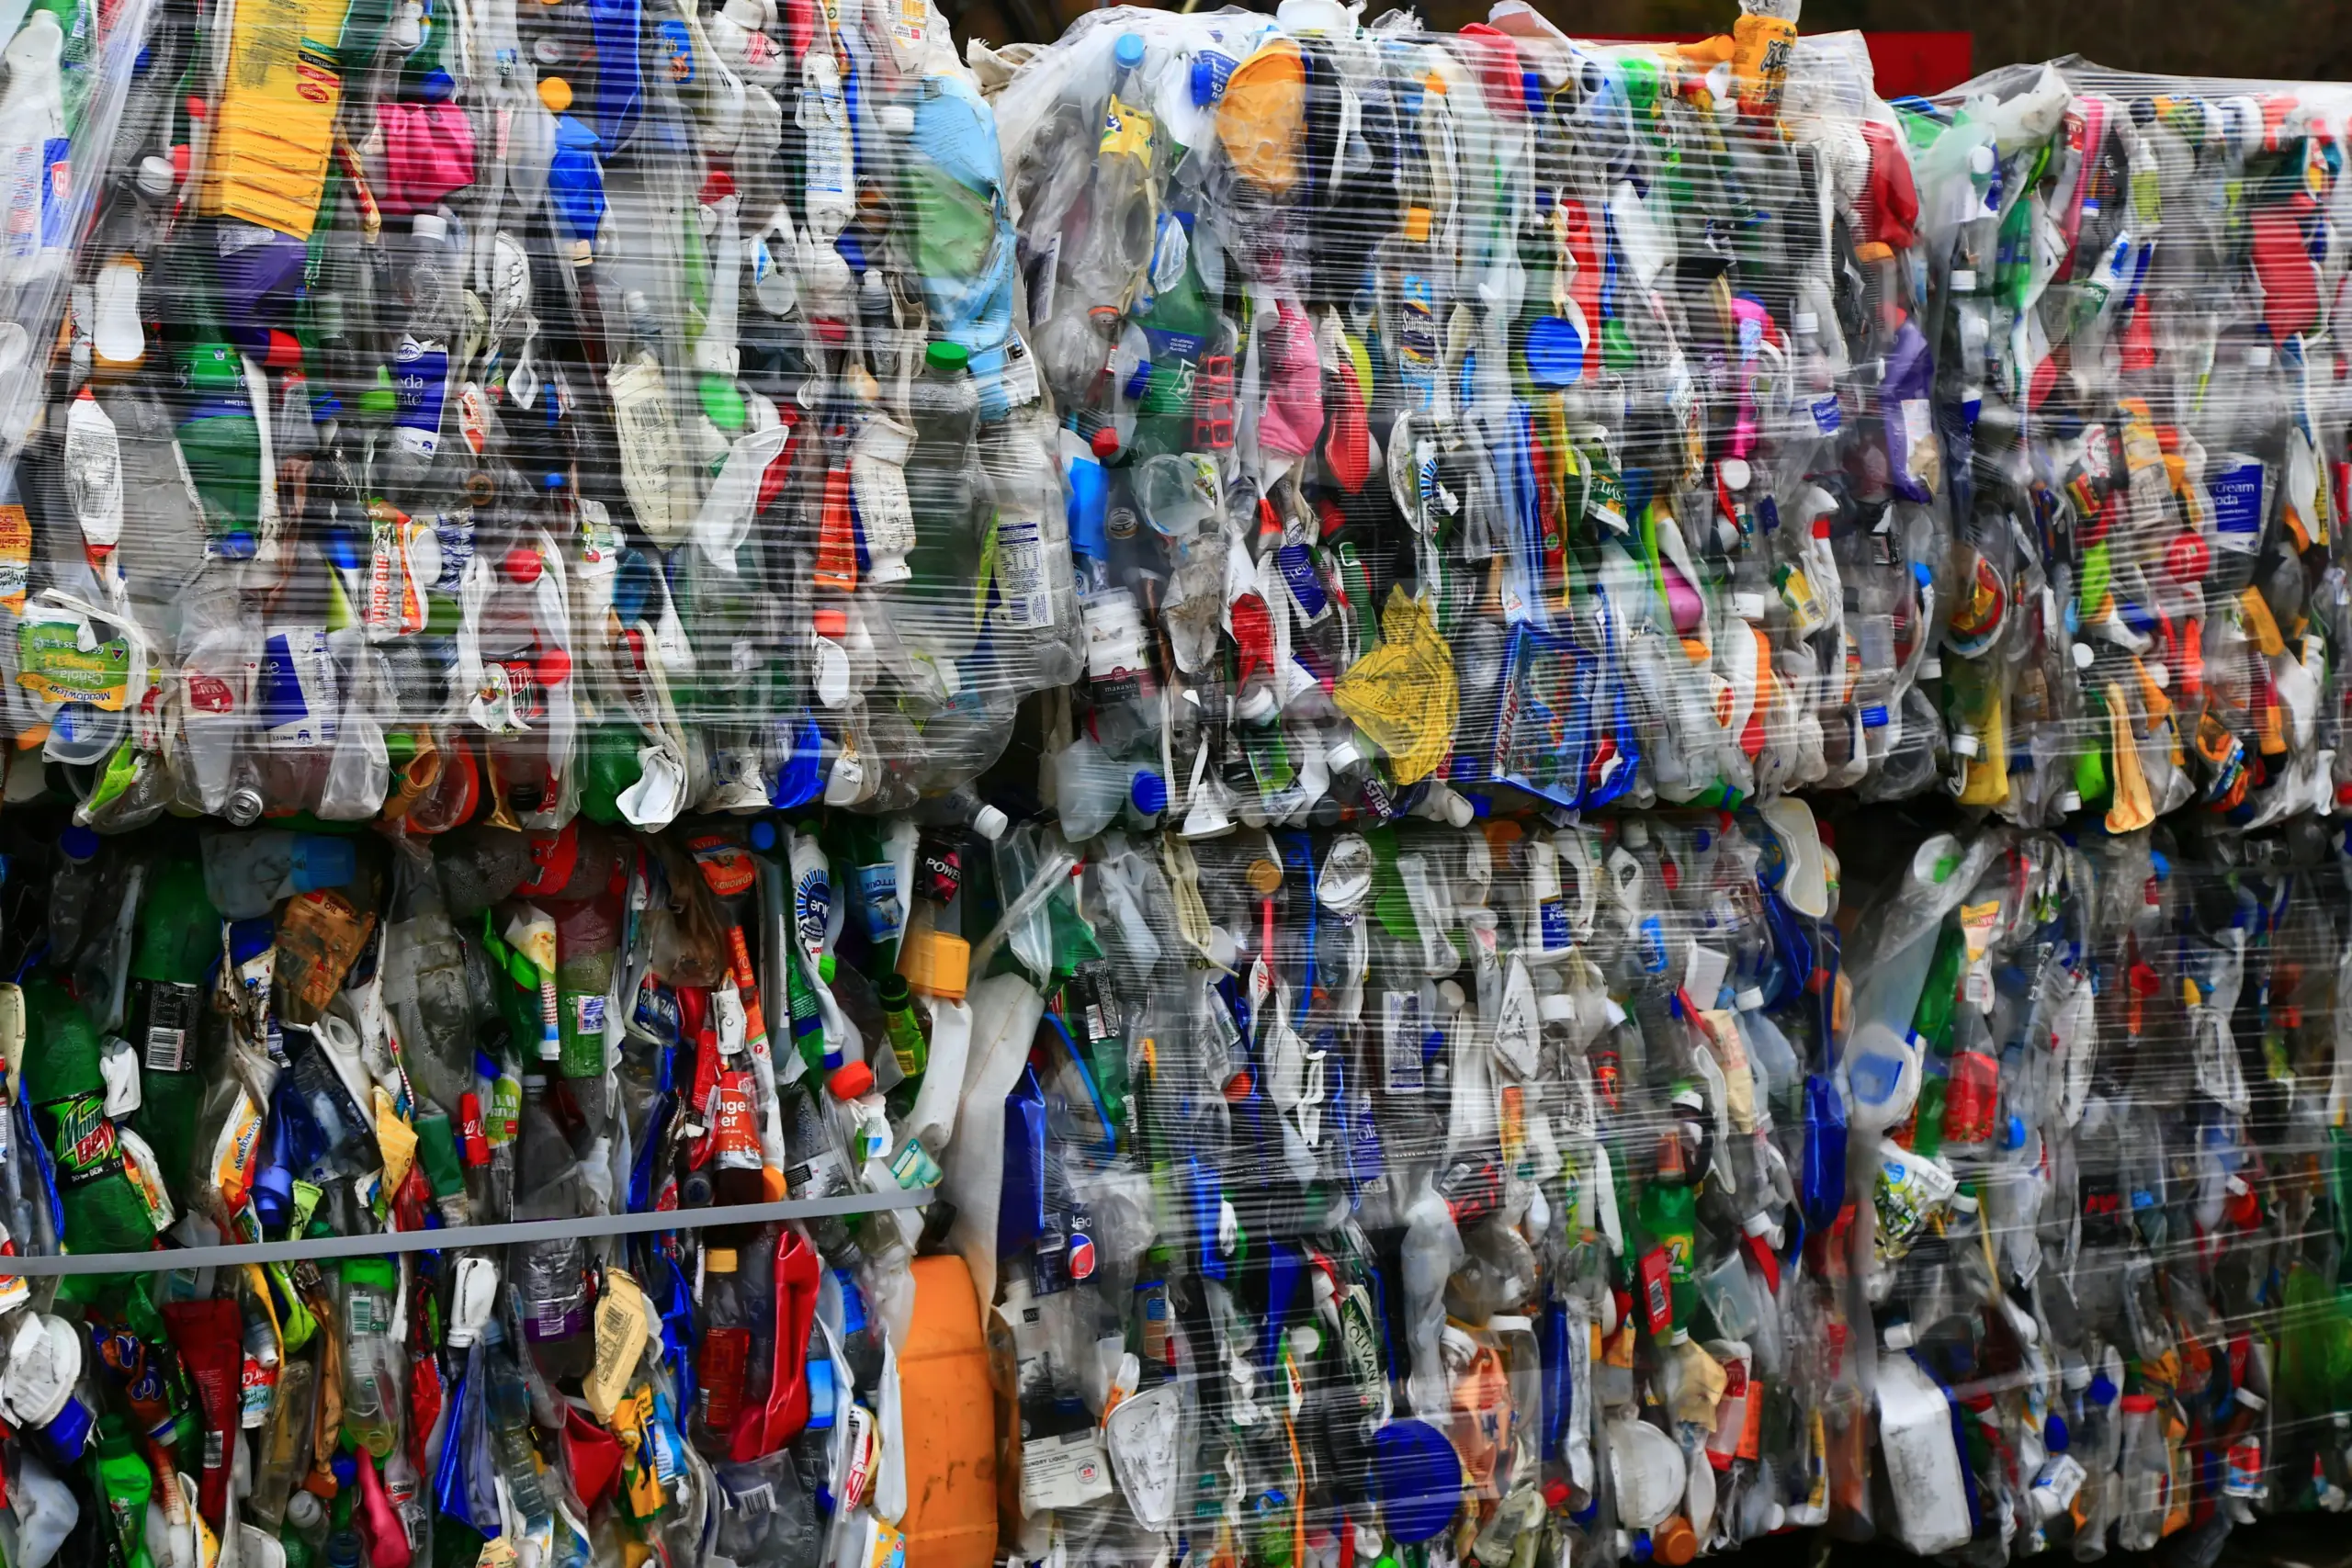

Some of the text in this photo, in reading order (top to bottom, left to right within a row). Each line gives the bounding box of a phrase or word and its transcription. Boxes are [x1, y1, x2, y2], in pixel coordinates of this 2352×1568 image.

[59, 669, 104, 685] Canola
[865, 877, 896, 890] ITTORIA
[324, 902, 338, 915] OIL
[1023, 1454, 1069, 1468] AUNDRY LIQUID
